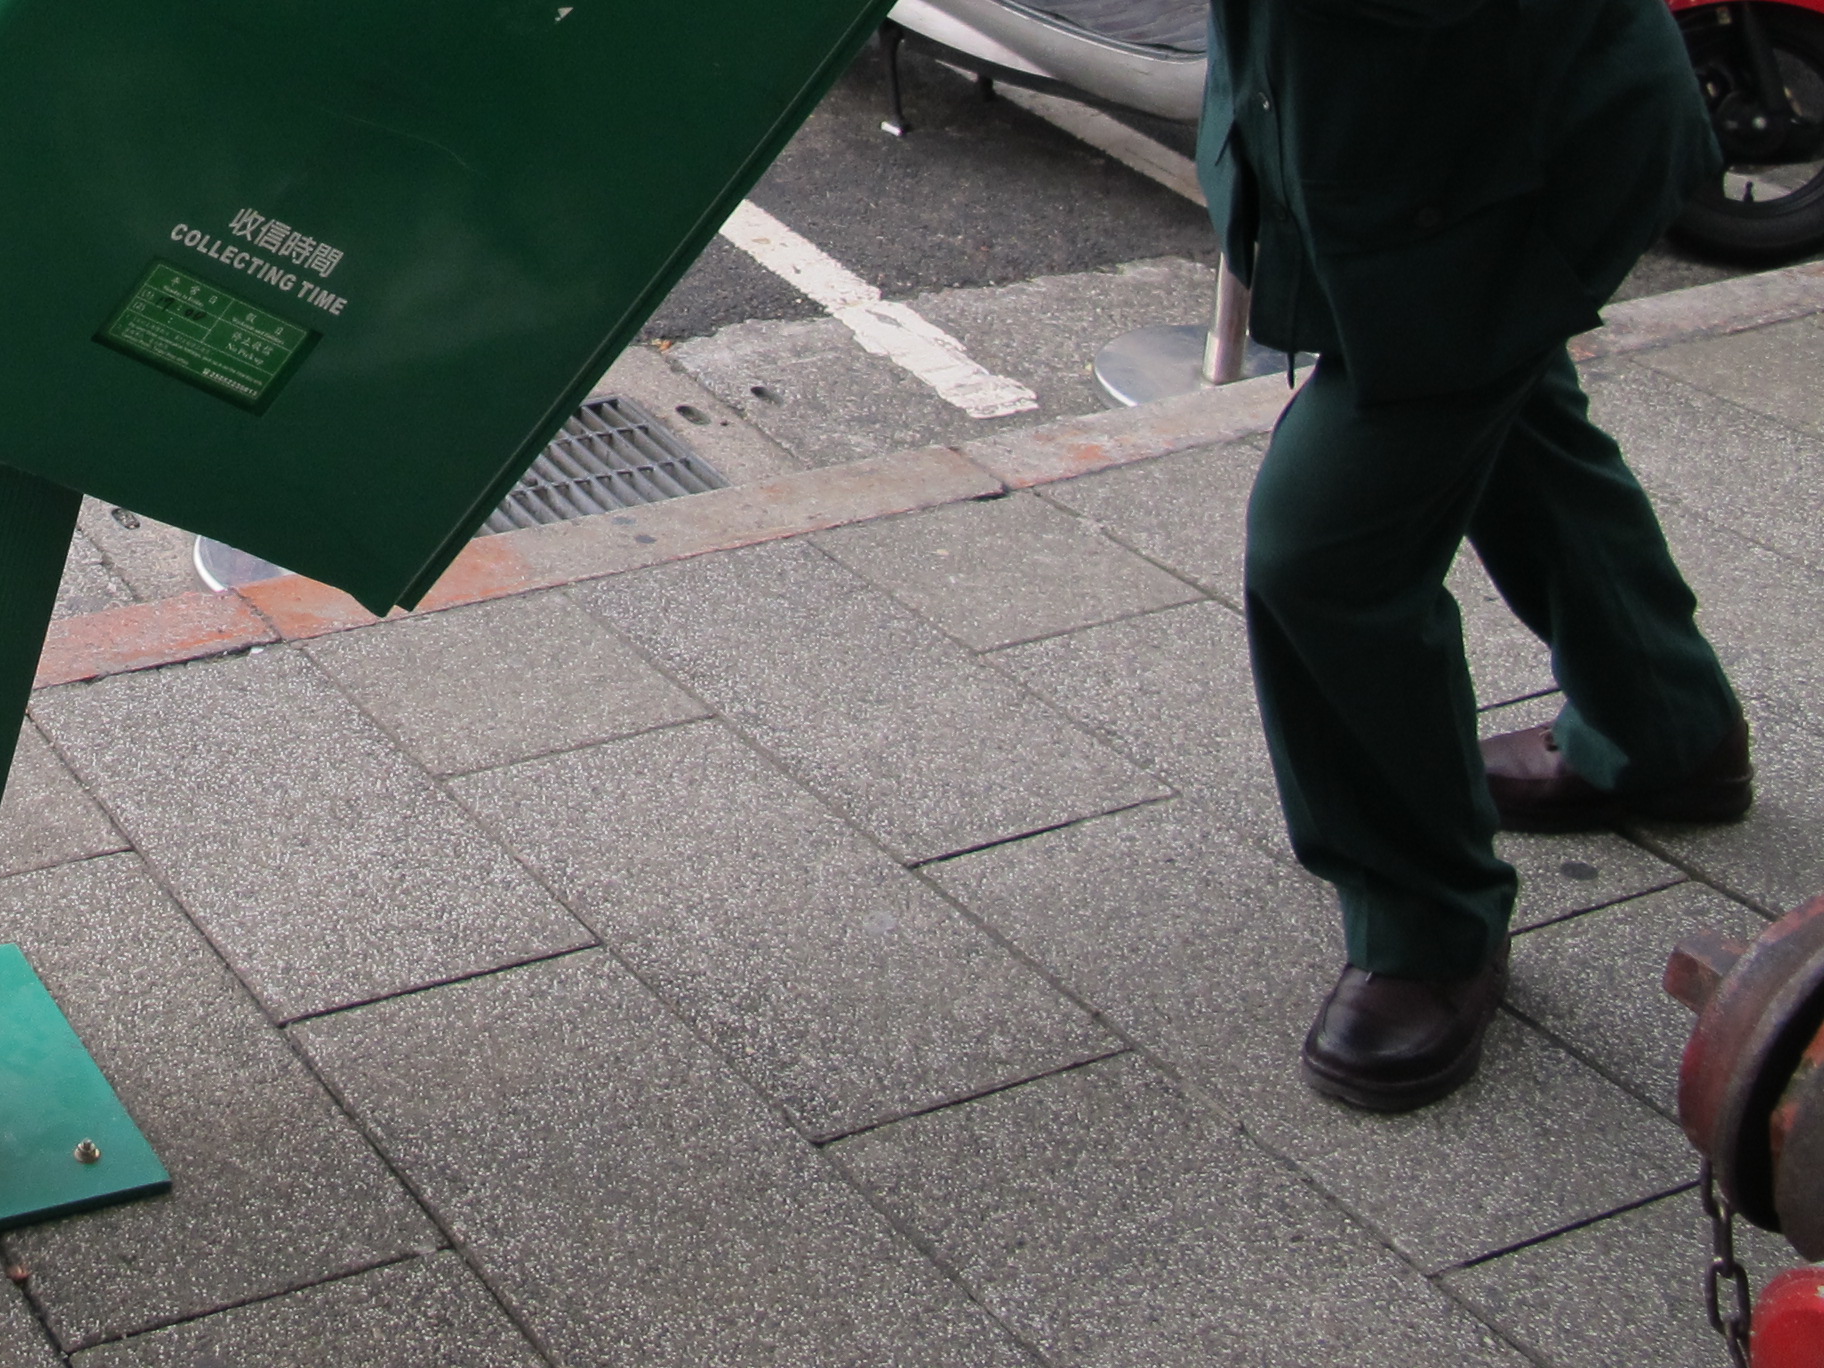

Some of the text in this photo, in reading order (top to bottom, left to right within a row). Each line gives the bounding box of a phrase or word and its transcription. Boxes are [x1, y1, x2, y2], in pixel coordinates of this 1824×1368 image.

[170, 223, 348, 316] COLLECTING TIME
[228, 207, 345, 278] 收信時間
